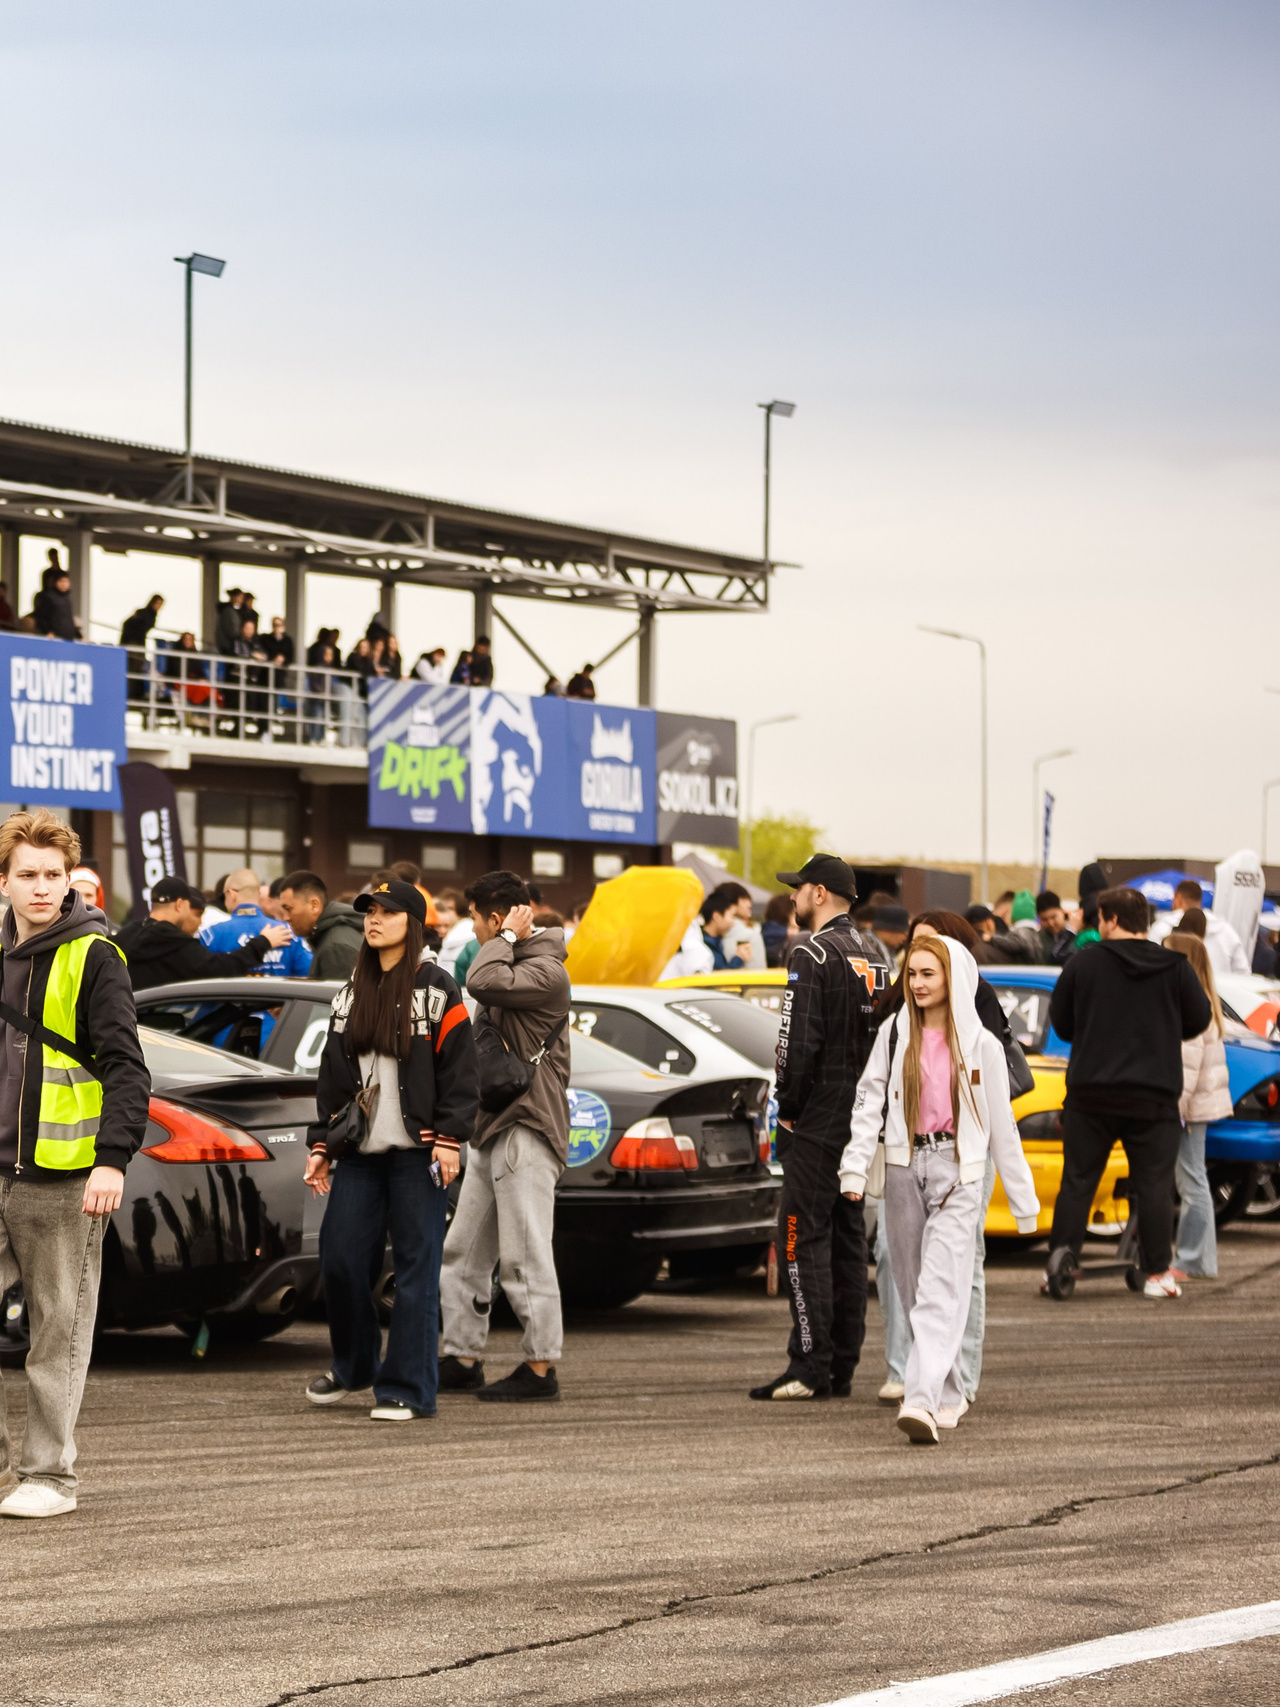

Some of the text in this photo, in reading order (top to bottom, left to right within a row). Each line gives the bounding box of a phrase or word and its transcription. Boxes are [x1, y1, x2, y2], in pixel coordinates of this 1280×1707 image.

[11, 656, 93, 706] POWER
[11, 701, 74, 747] YOUR
[11, 744, 116, 793] INSTINCT
[378, 740, 466, 803] DRIFT
[581, 760, 643, 813] GORILLA
[786, 1215, 812, 1353] RACING TECHNOLOGIES
